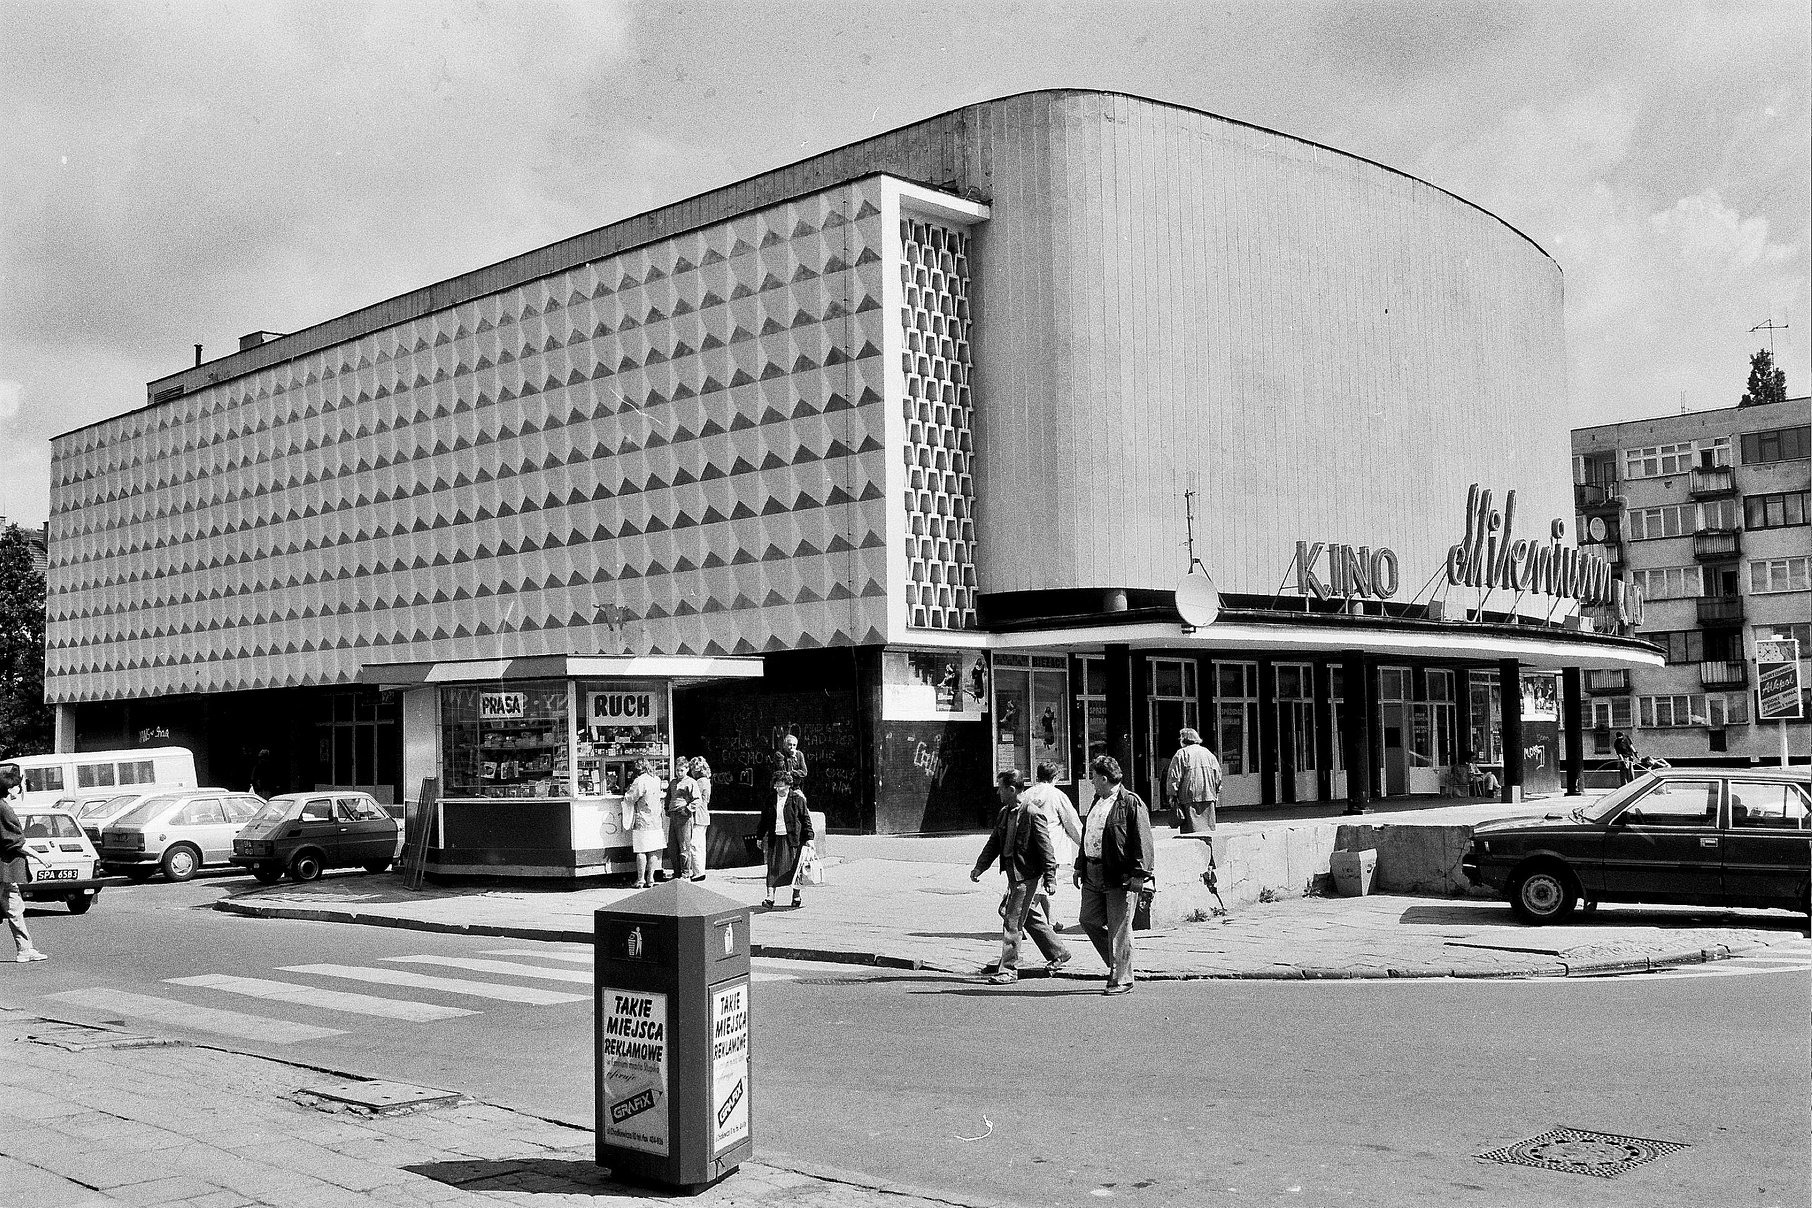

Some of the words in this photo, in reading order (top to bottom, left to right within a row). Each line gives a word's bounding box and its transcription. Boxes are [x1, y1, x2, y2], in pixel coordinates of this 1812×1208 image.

[1296, 541, 1399, 602] KINO
[482, 695, 521, 715] PRASA
[594, 694, 650, 718] RUCH
[38, 871, 55, 880] SPA
[57, 870, 78, 879] 6583
[615, 995, 653, 1018] TAKIE
[720, 992, 740, 1016] TAKIE
[607, 1016, 663, 1042] MIEJSCA
[715, 1011, 747, 1039] MIEJSCA
[604, 1038, 663, 1062] REKLAMOWE
[713, 1033, 746, 1060] REKLAMOWE
[613, 1092, 652, 1119] GRAFIX
